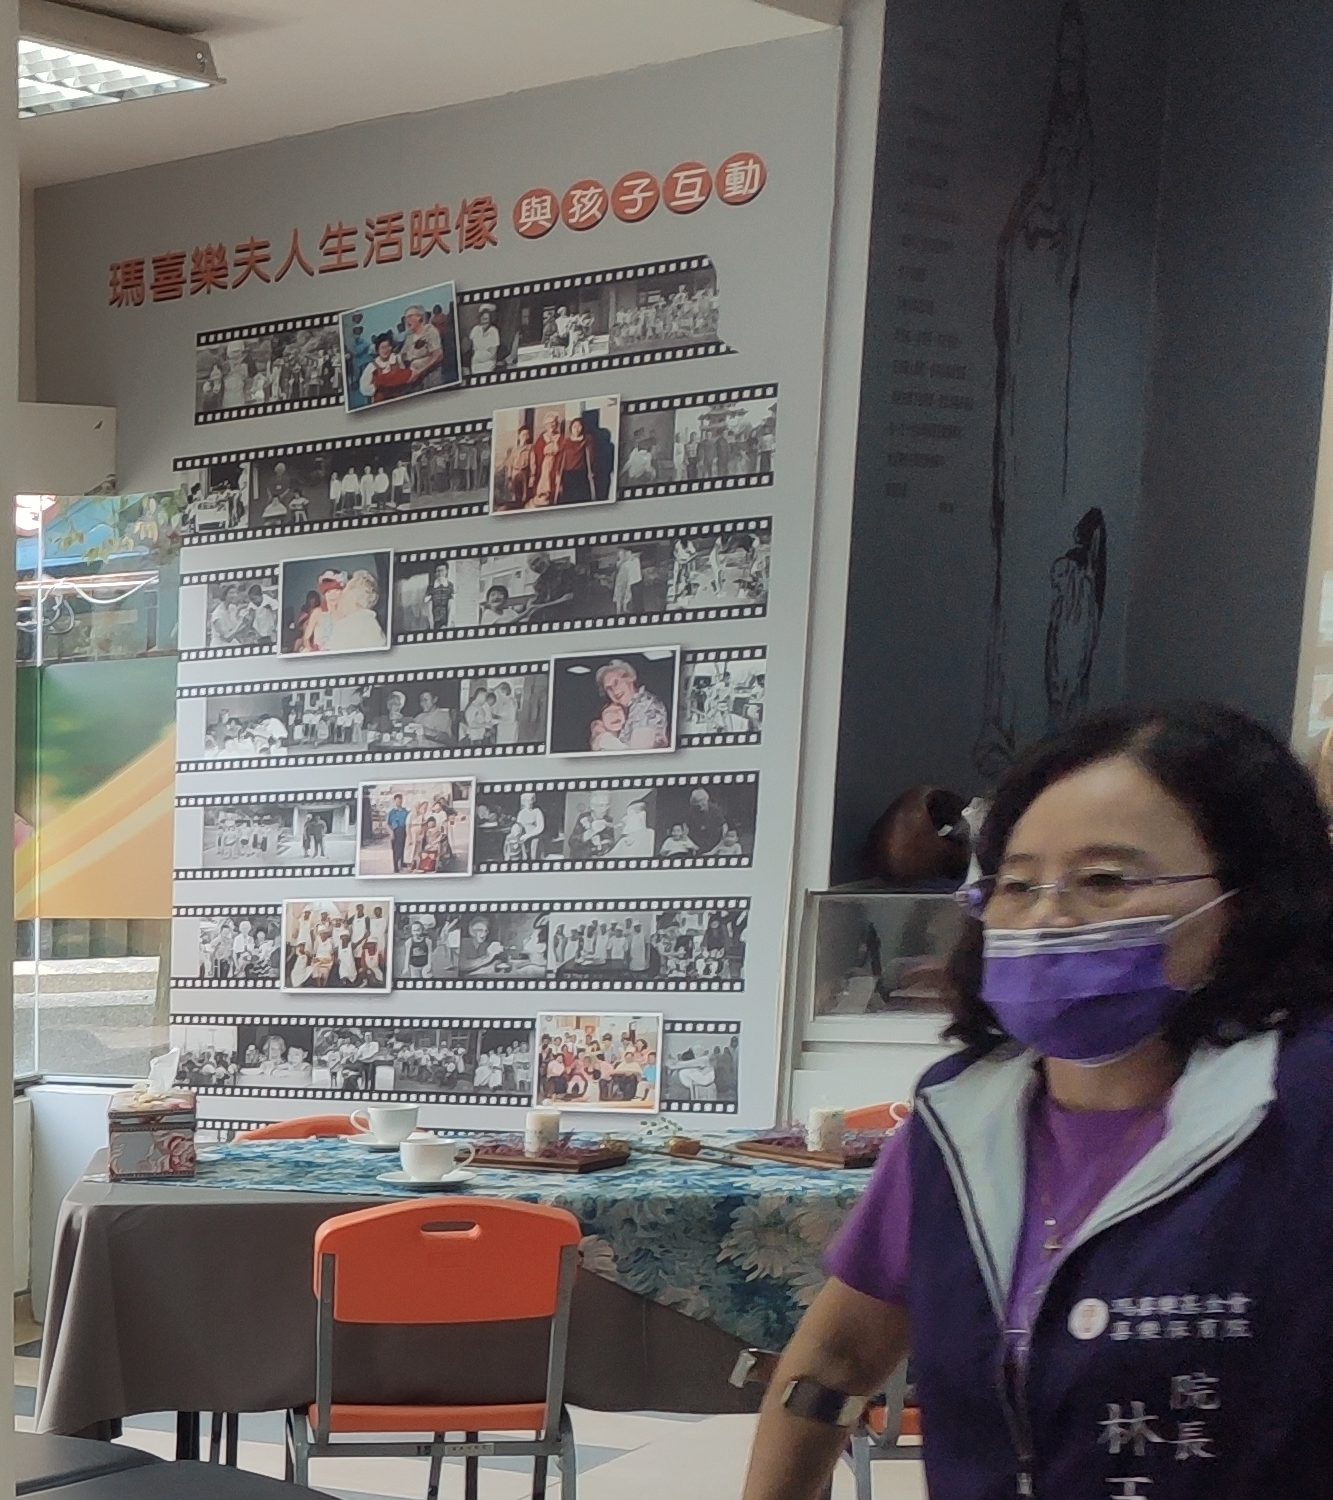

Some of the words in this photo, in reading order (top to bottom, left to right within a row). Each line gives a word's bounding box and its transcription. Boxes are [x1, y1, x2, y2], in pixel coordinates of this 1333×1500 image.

[107, 196, 499, 309] 瑪喜樂夫人生活映像
[518, 156, 764, 231] 與孩子互動
[1169, 1370, 1222, 1461] 院長
